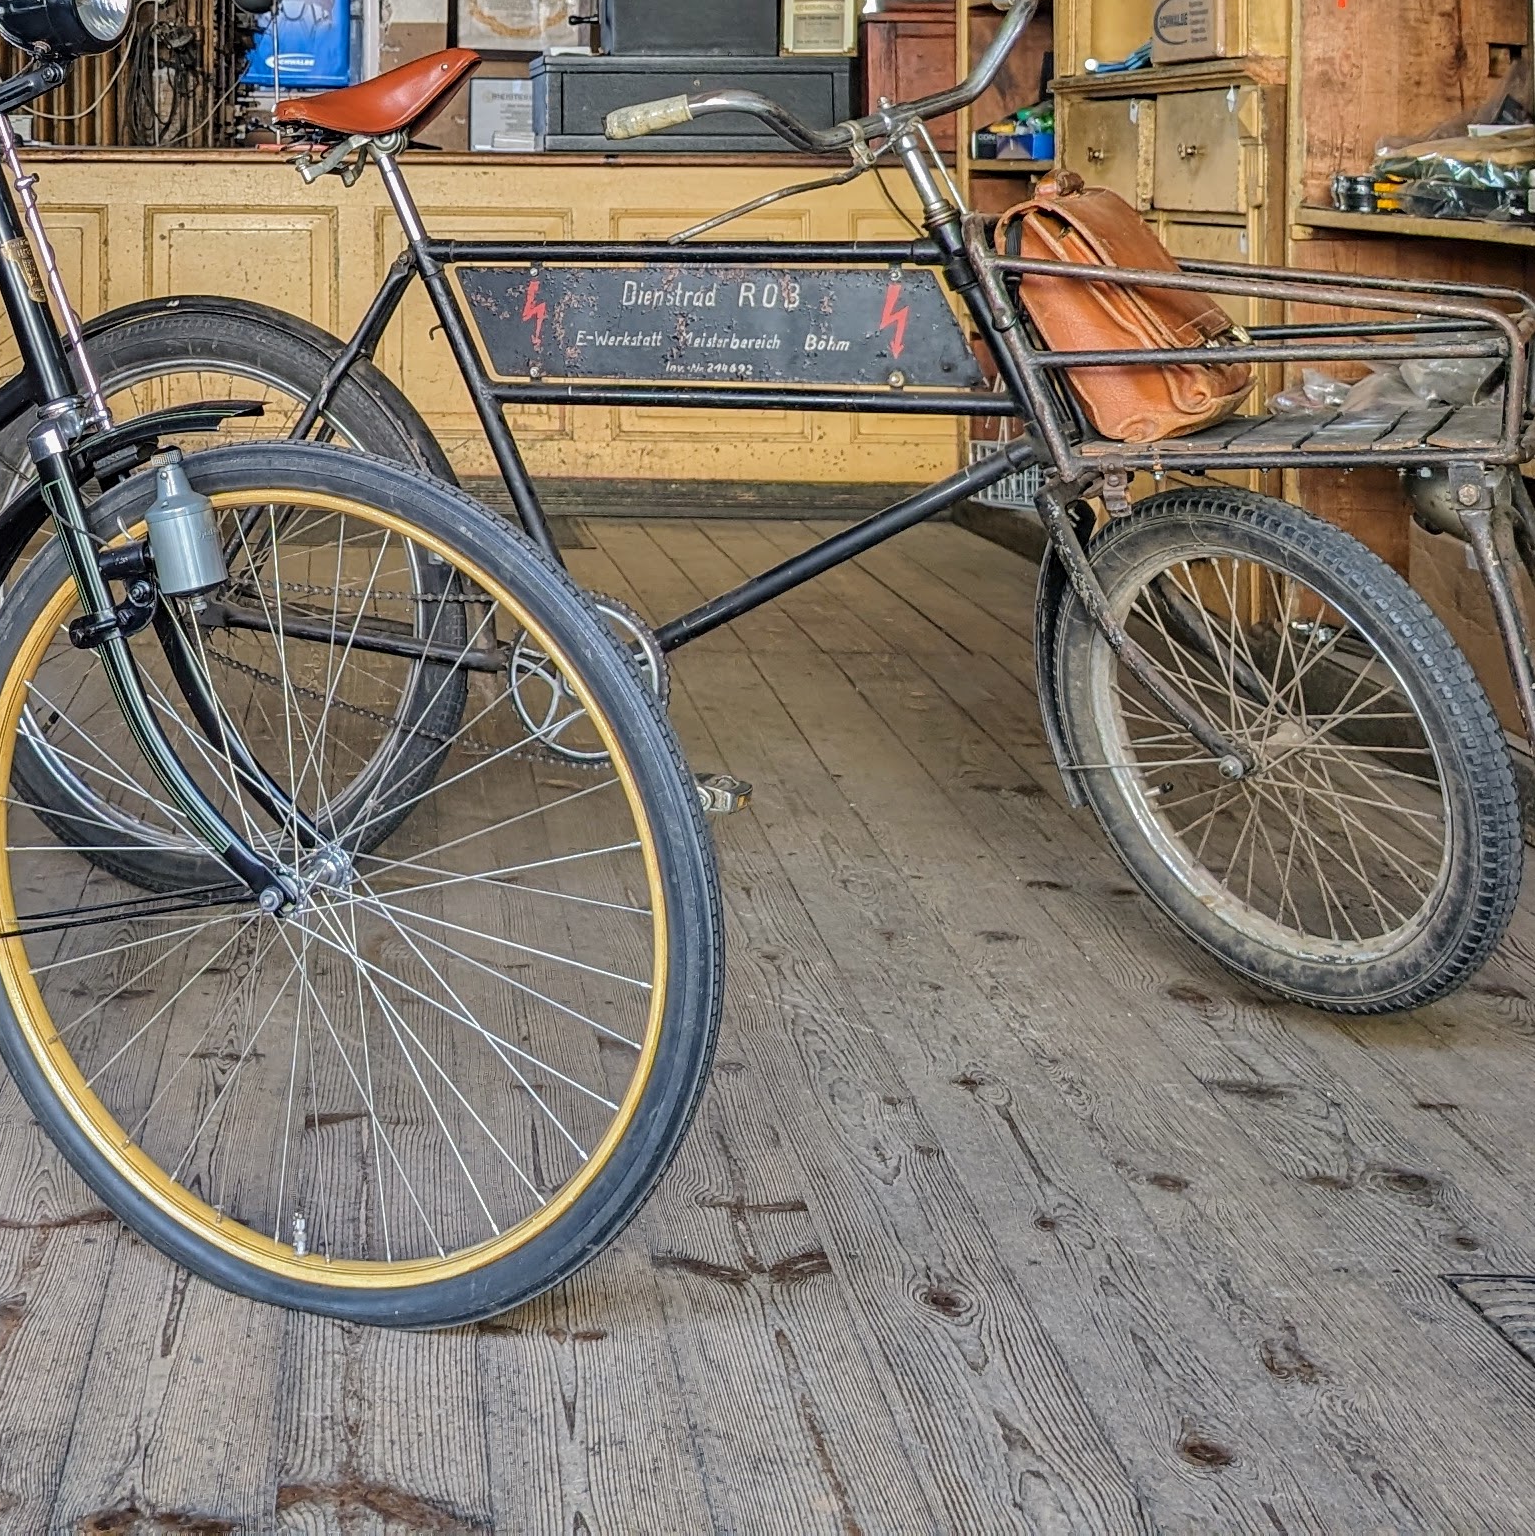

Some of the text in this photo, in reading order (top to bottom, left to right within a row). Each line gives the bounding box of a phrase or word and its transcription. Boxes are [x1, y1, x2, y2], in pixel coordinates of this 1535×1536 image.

[277, 58, 315, 67] CHWALBE
[622, 280, 717, 308] Dienstrad
[575, 330, 663, 348] E-Werkstatt
[804, 332, 851, 352] Böhm
[706, 362, 754, 375] 214692
